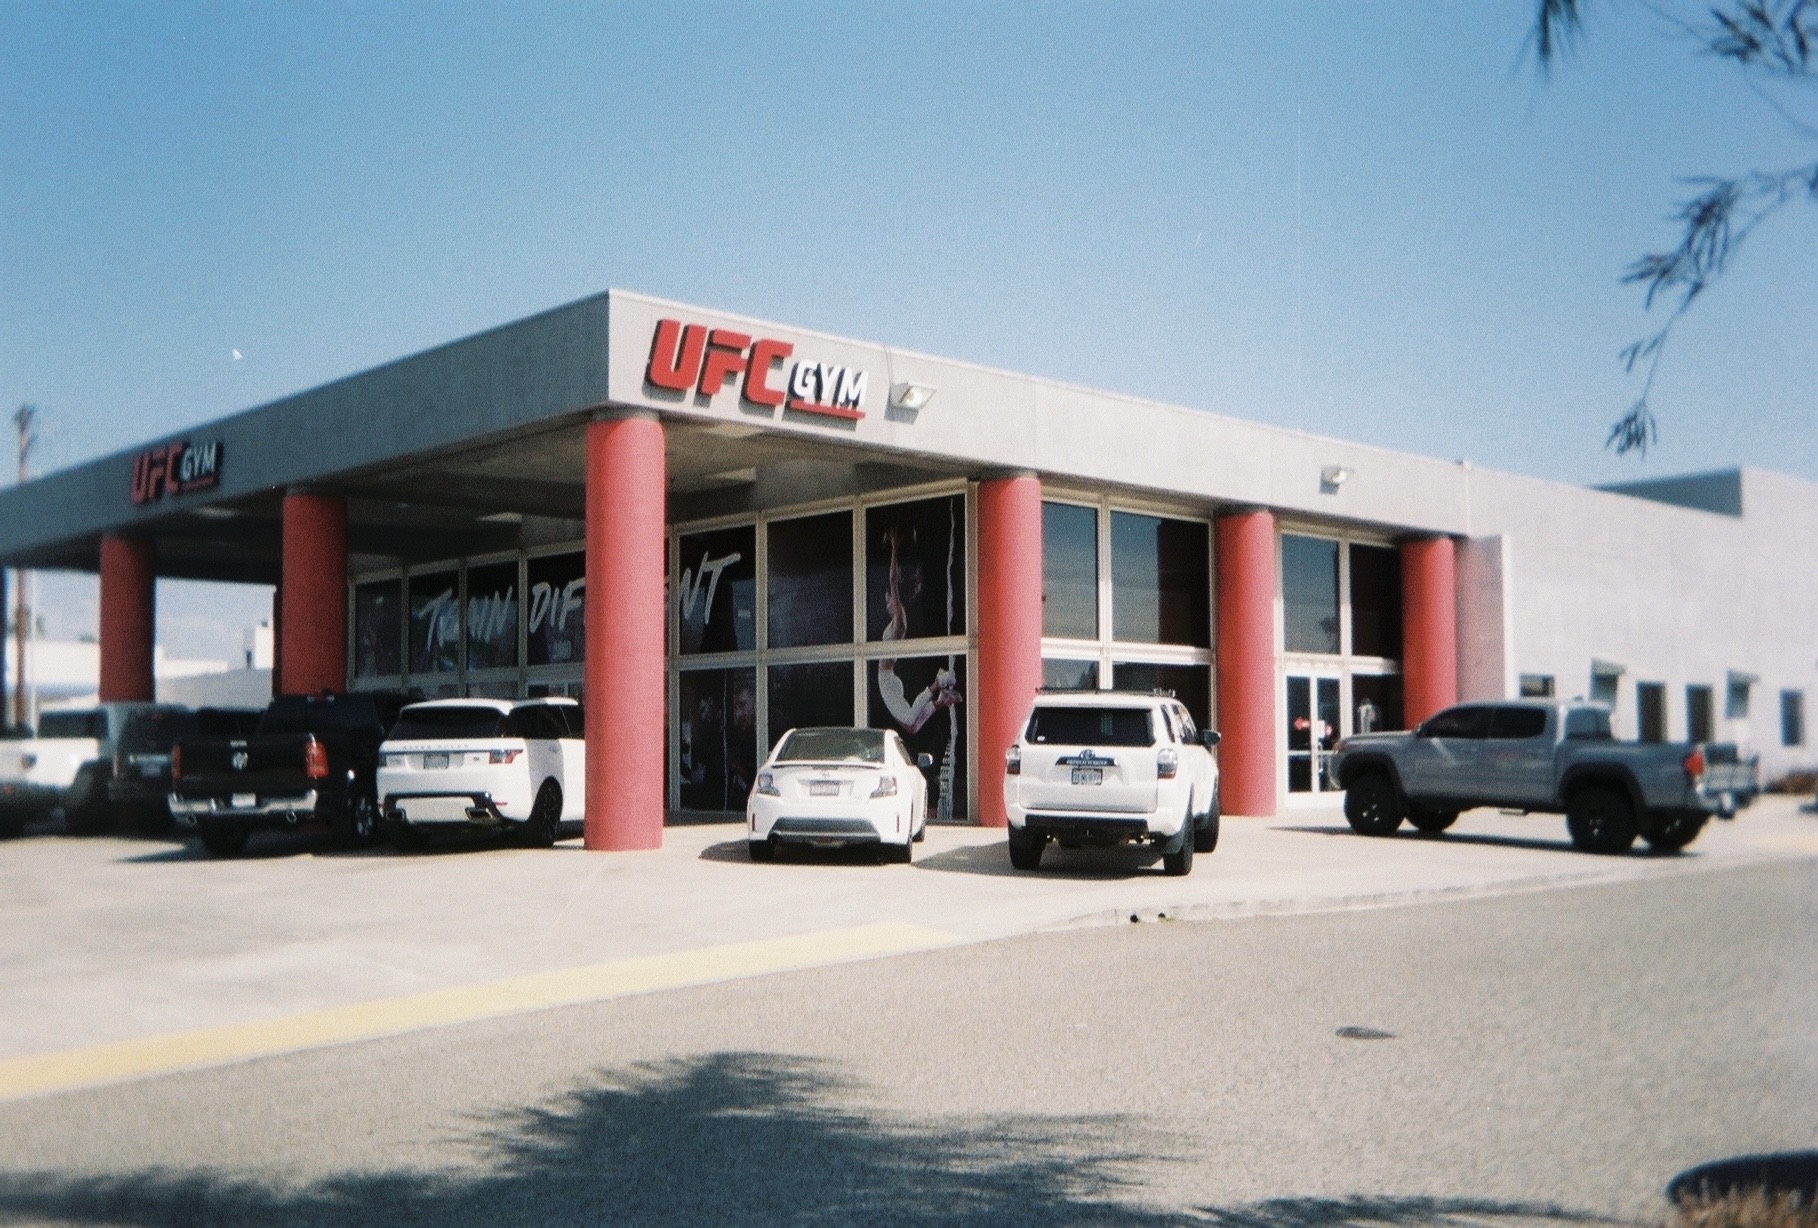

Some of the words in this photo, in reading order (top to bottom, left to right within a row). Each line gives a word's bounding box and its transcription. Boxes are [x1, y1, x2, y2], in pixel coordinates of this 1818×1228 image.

[647, 318, 794, 407] UFC
[792, 359, 869, 411] GYM
[131, 440, 182, 504] UFC
[180, 440, 217, 482] GYM
